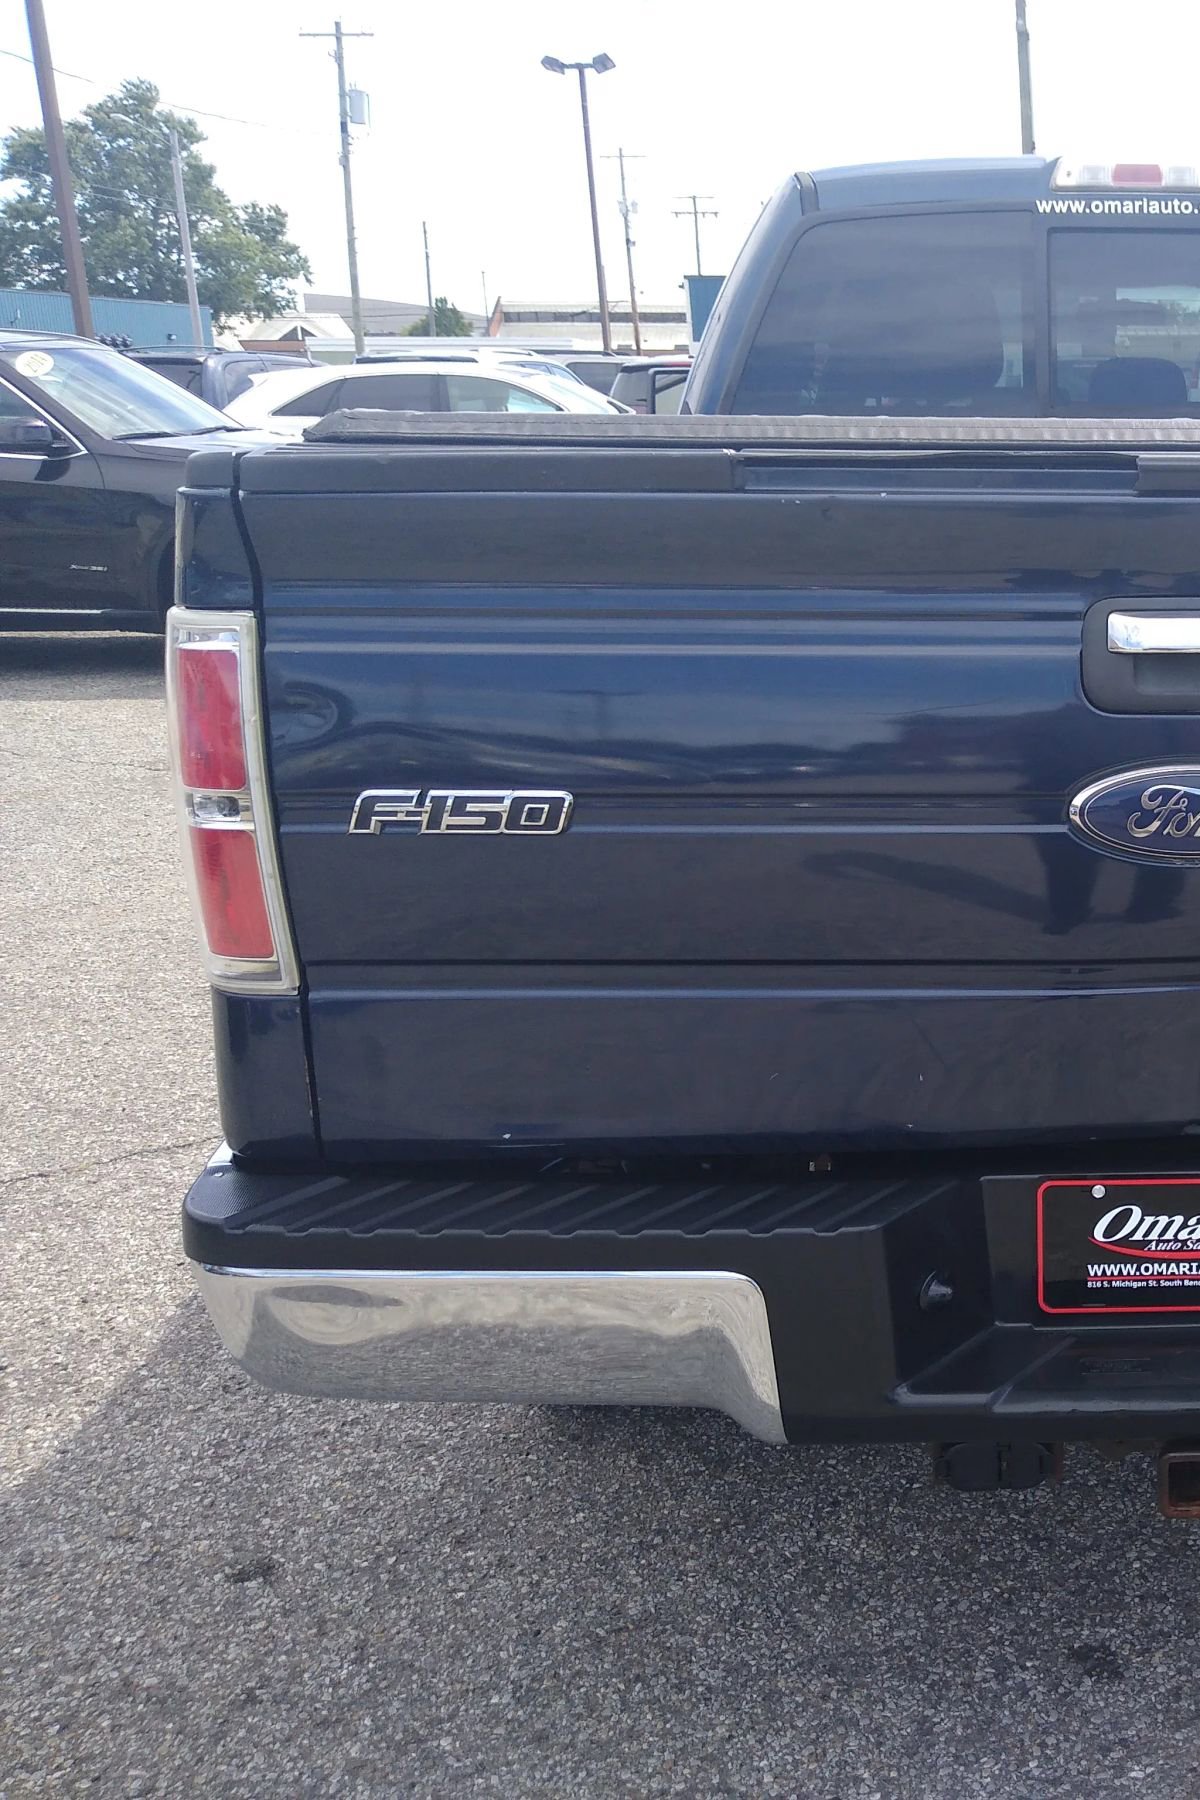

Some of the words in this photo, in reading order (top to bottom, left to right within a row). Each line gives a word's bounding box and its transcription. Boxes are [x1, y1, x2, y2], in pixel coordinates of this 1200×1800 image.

[348, 789, 574, 834] F-150
[1144, 1239, 1181, 1250] Auto
[1112, 1280, 1147, 1289] Michigan
[1160, 1279, 1183, 1287] South
